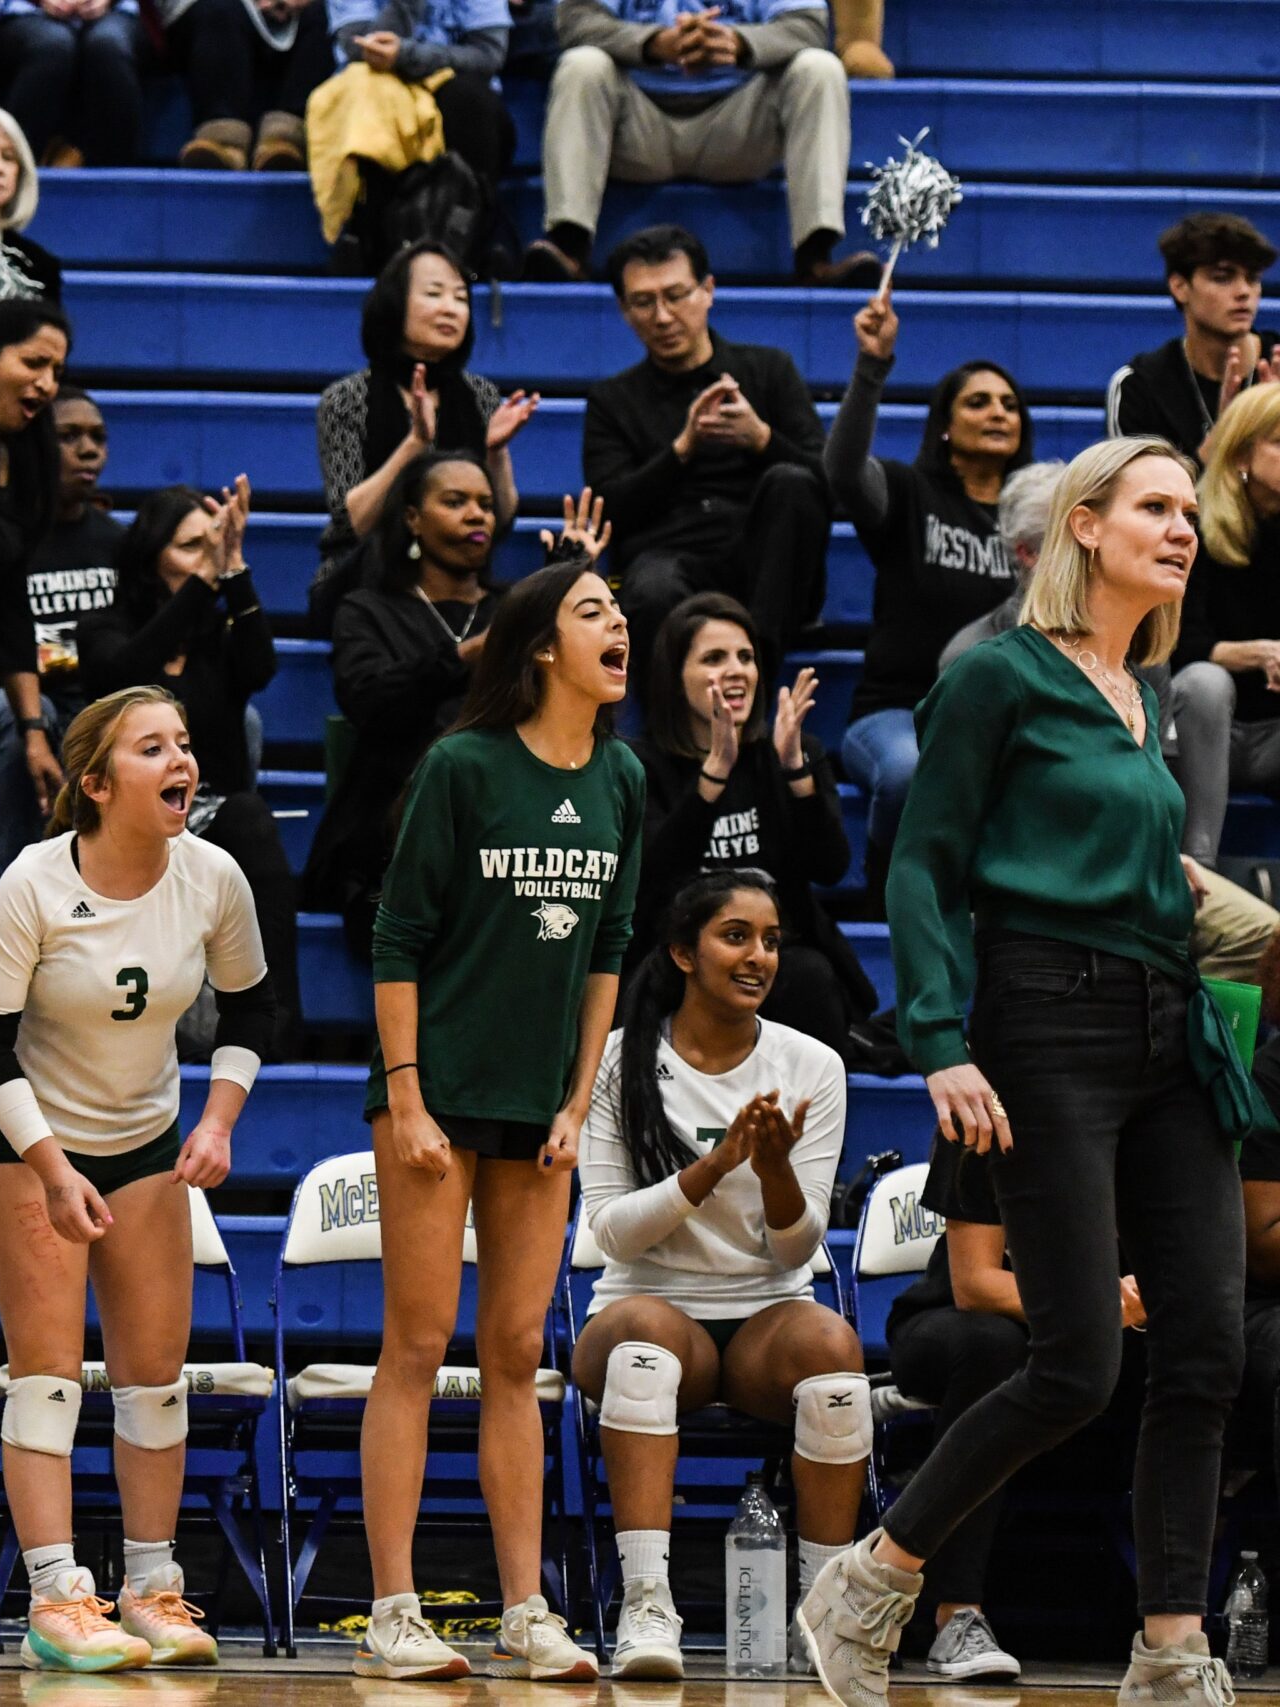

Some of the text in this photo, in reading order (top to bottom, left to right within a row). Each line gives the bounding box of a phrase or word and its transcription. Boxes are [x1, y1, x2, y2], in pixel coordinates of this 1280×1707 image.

[551, 815, 581, 824] adidas
[514, 880, 601, 900] VOLLEYBALL
[111, 967, 148, 1021] 3
